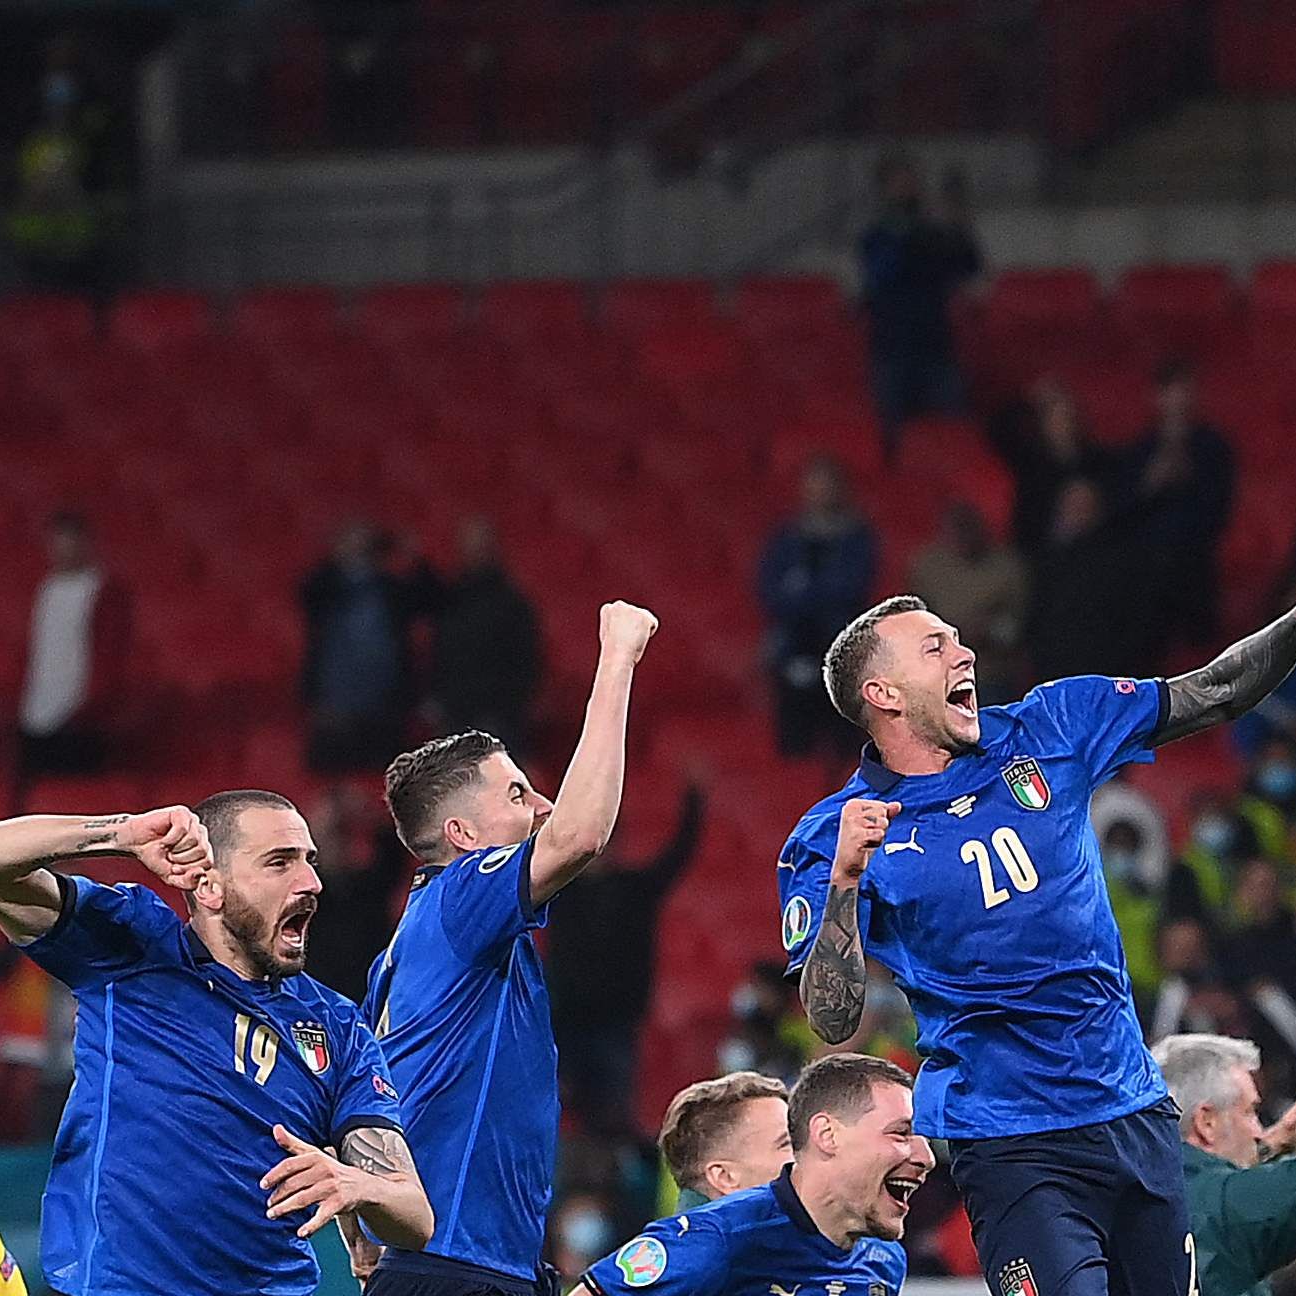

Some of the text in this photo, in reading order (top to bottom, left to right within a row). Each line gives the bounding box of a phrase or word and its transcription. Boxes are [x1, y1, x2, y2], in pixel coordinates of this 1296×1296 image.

[1006, 762, 1035, 781] ITALIA
[960, 826, 1039, 910] 20
[234, 1012, 280, 1087] 19
